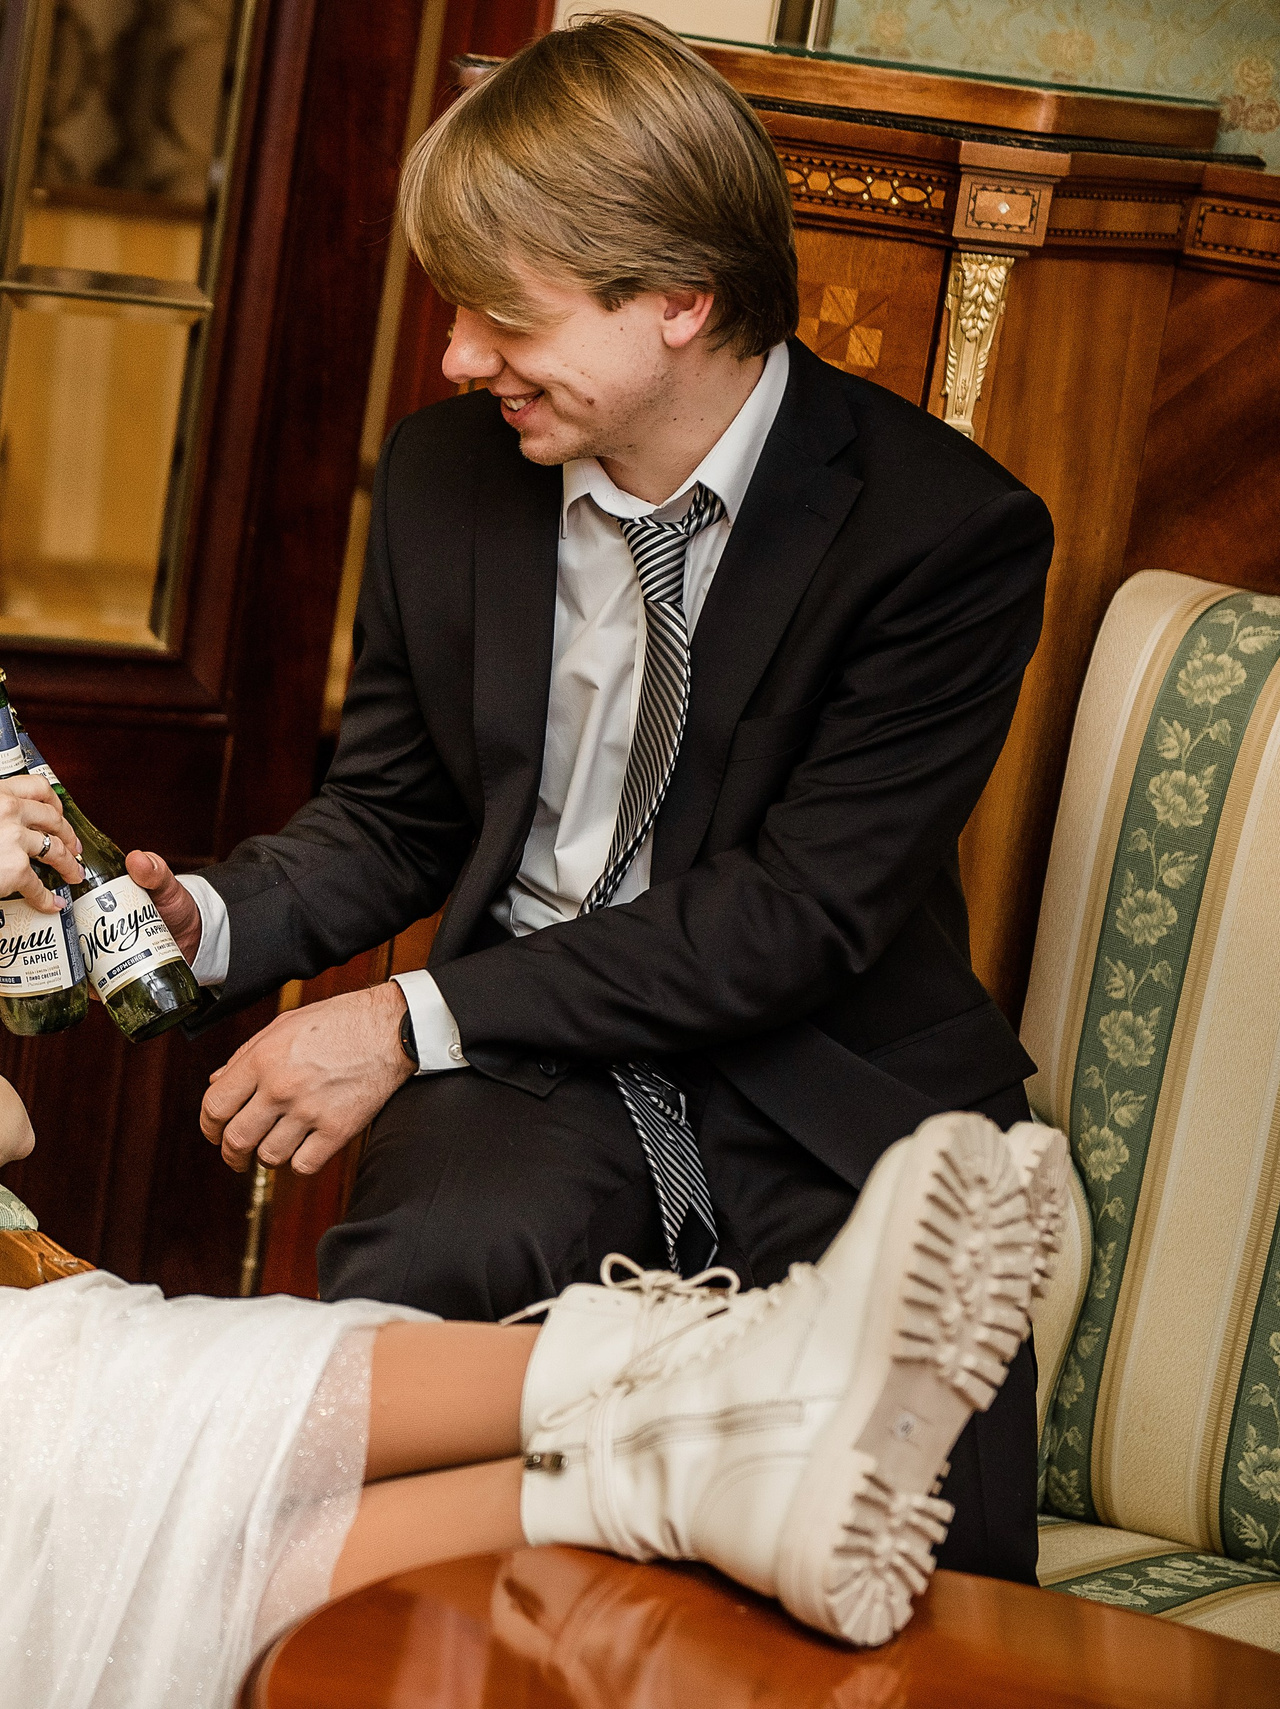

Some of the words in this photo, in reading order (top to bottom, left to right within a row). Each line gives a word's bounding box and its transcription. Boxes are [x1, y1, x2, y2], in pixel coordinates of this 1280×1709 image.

[79, 903, 162, 973] Жигули
[23, 949, 59, 966] БАРНОЕ
[111, 952, 147, 975] ФИРМЕННОЕ
